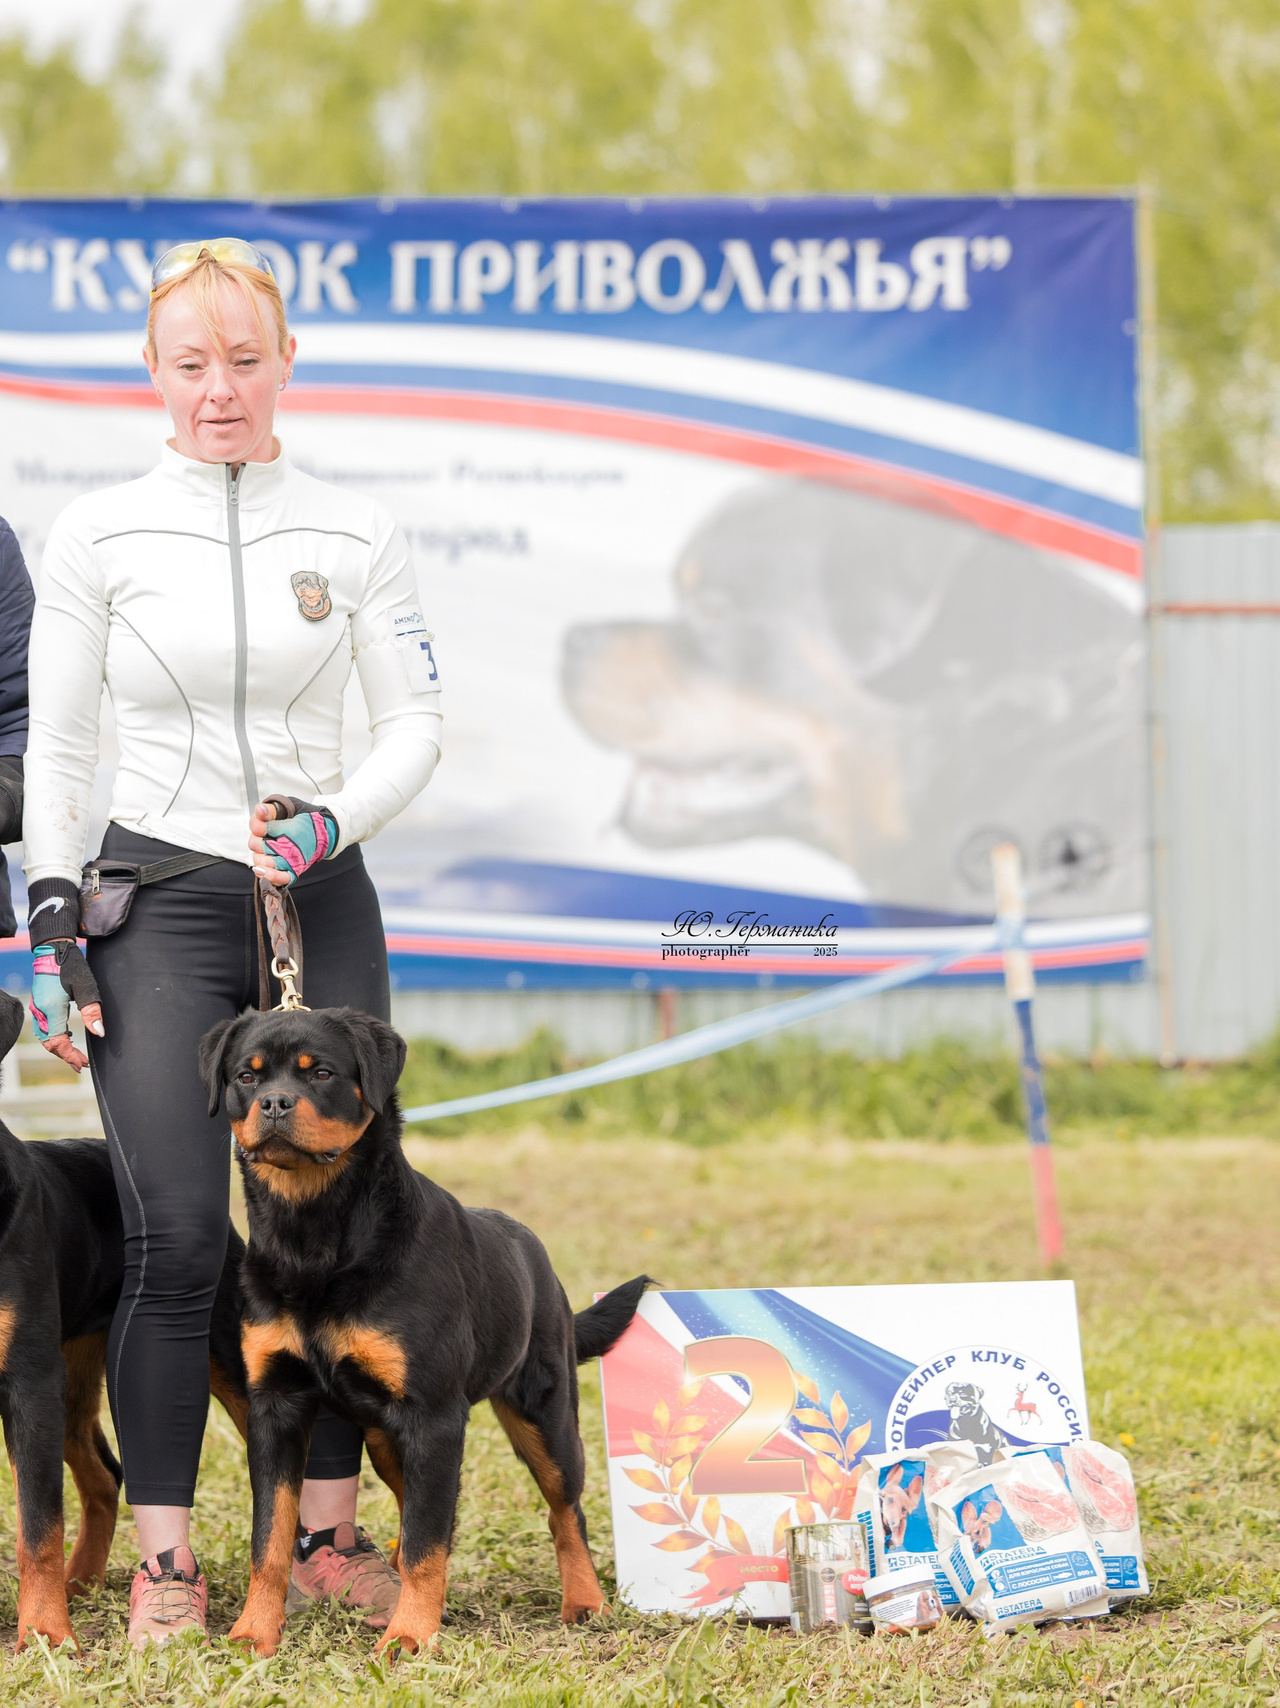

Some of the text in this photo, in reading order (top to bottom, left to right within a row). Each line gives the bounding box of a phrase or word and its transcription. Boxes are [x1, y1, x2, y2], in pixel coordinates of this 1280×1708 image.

[6, 237, 360, 314] “КУК
[971, 1350, 1027, 1371] КЛУБ
[684, 1335, 809, 1496] 2
[898, 1555, 939, 1567] STATE
[988, 1546, 1045, 1561] STATERA
[1017, 1576, 1050, 1588] ЛОСОСЕМ
[1003, 1598, 1042, 1614] STATERA
